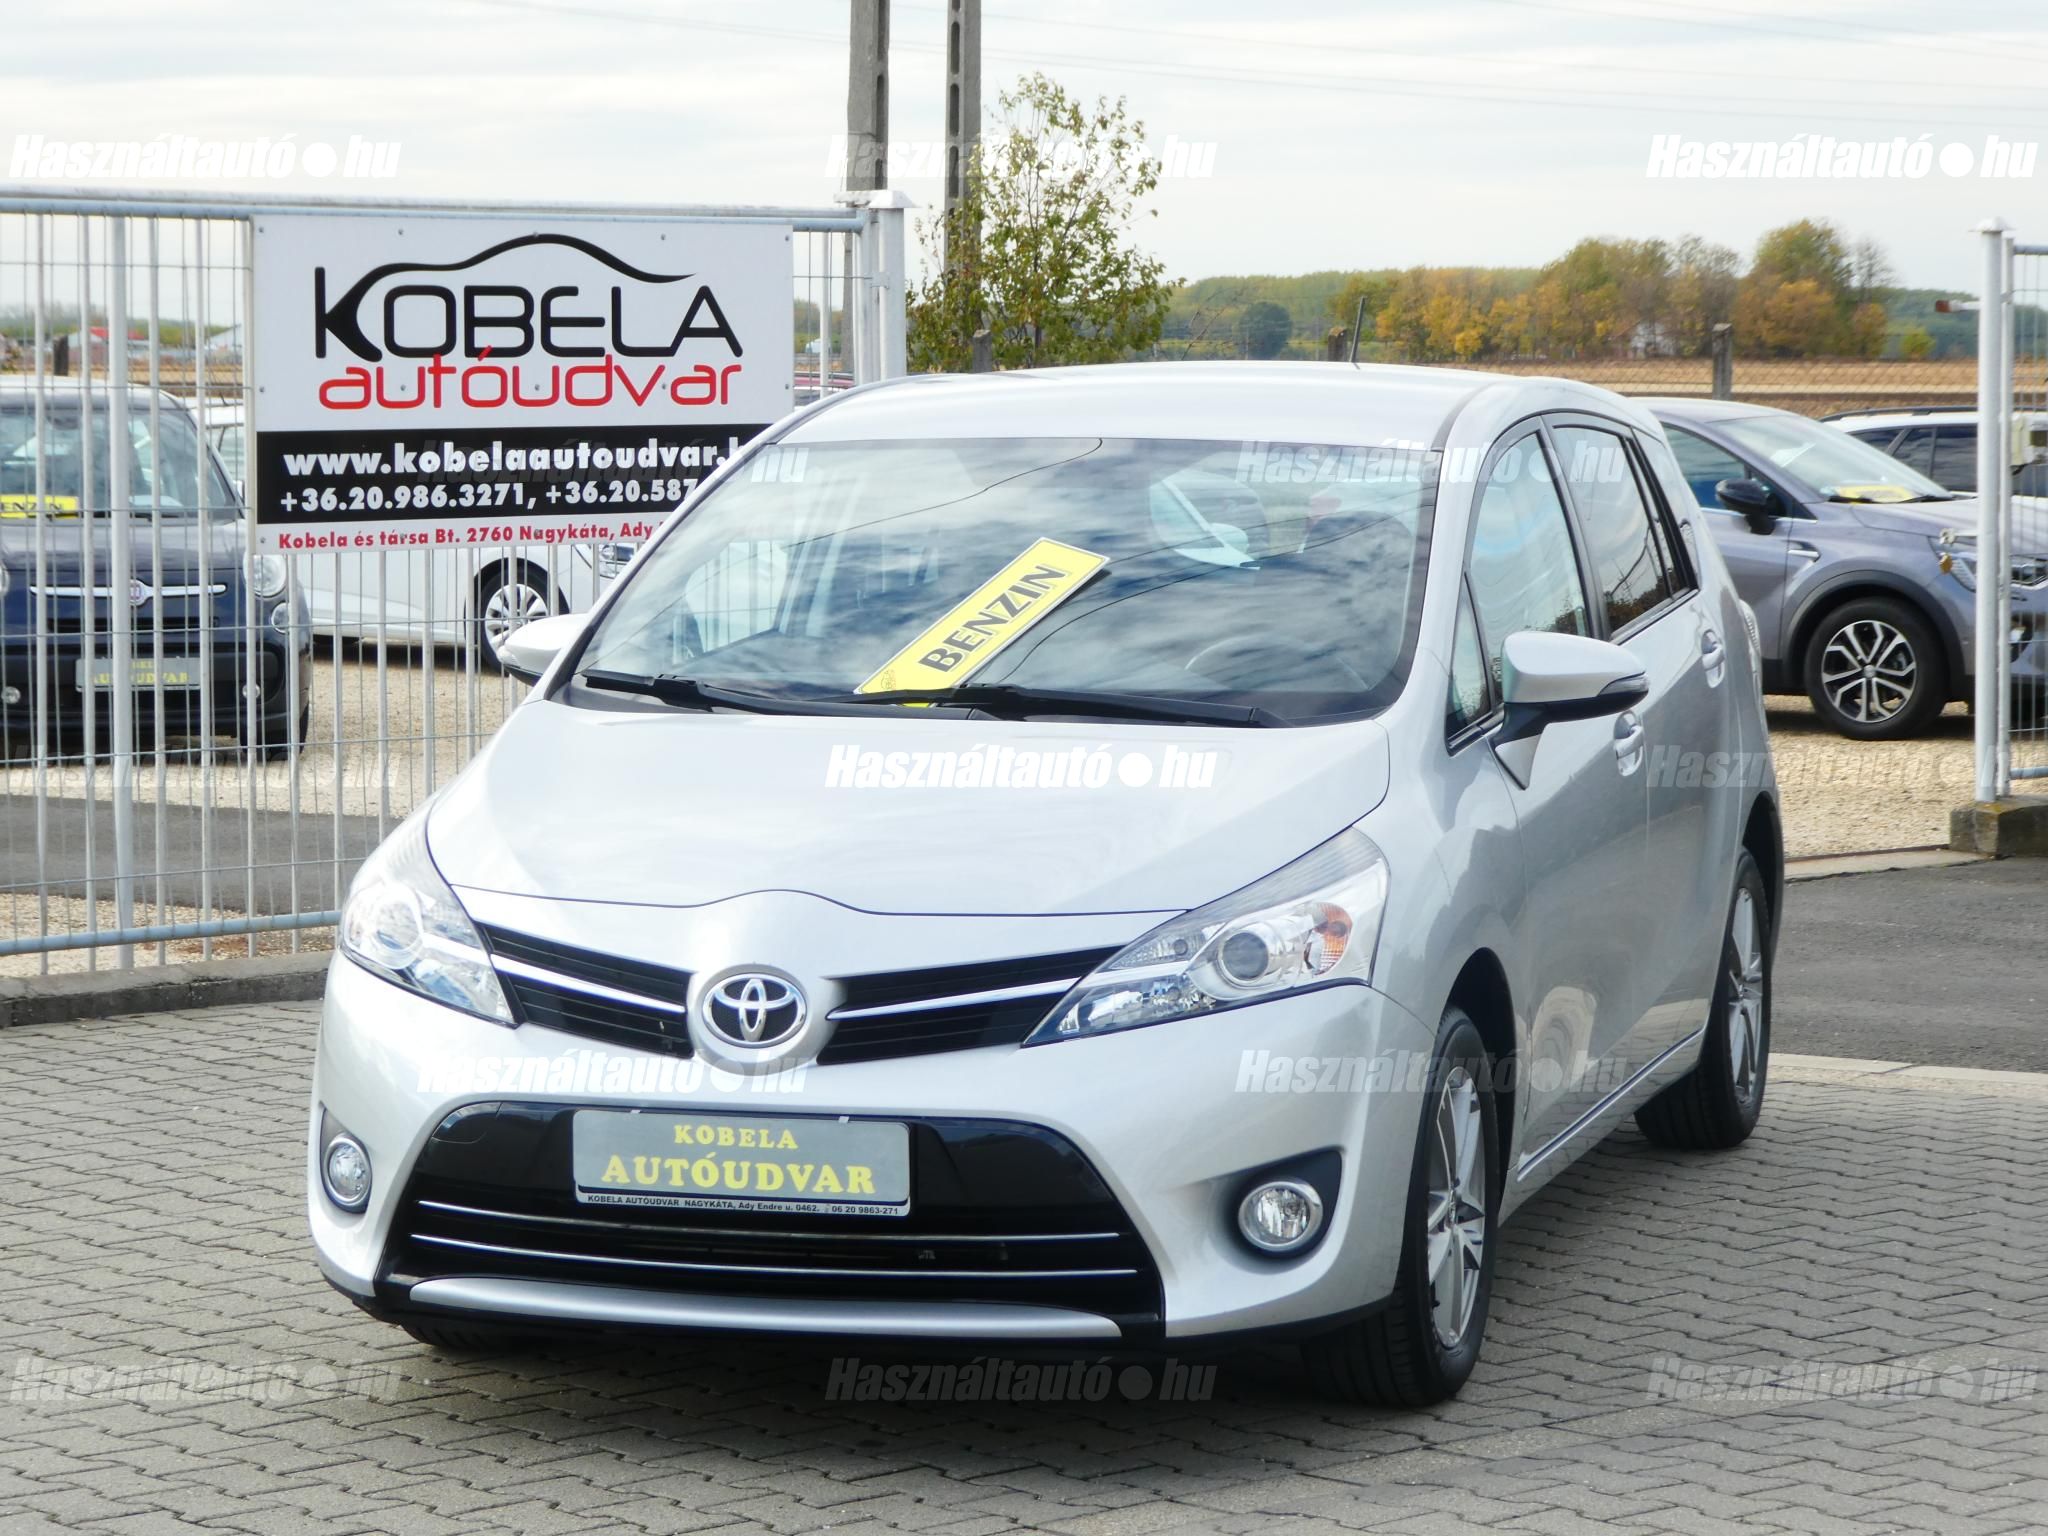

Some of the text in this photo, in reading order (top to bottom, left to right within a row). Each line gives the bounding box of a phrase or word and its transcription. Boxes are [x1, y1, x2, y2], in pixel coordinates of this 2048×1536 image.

[315, 266, 743, 362] KOBELA
[319, 345, 742, 409] autóudvar
[281, 482, 537, 512] +36.20.986.3271,
[279, 520, 653, 549] Kobela és társa Bt. 2760 Nagykáta, Ady
[918, 565, 1067, 673] BENZIN
[674, 1124, 798, 1149] KOBELA
[602, 1152, 875, 1194] AUTÓUDVAR
[587, 1194, 623, 1204] KOBELA
[738, 1202, 755, 1212] Ady
[757, 1203, 782, 1211] Endre
[832, 1205, 843, 1213] 06
